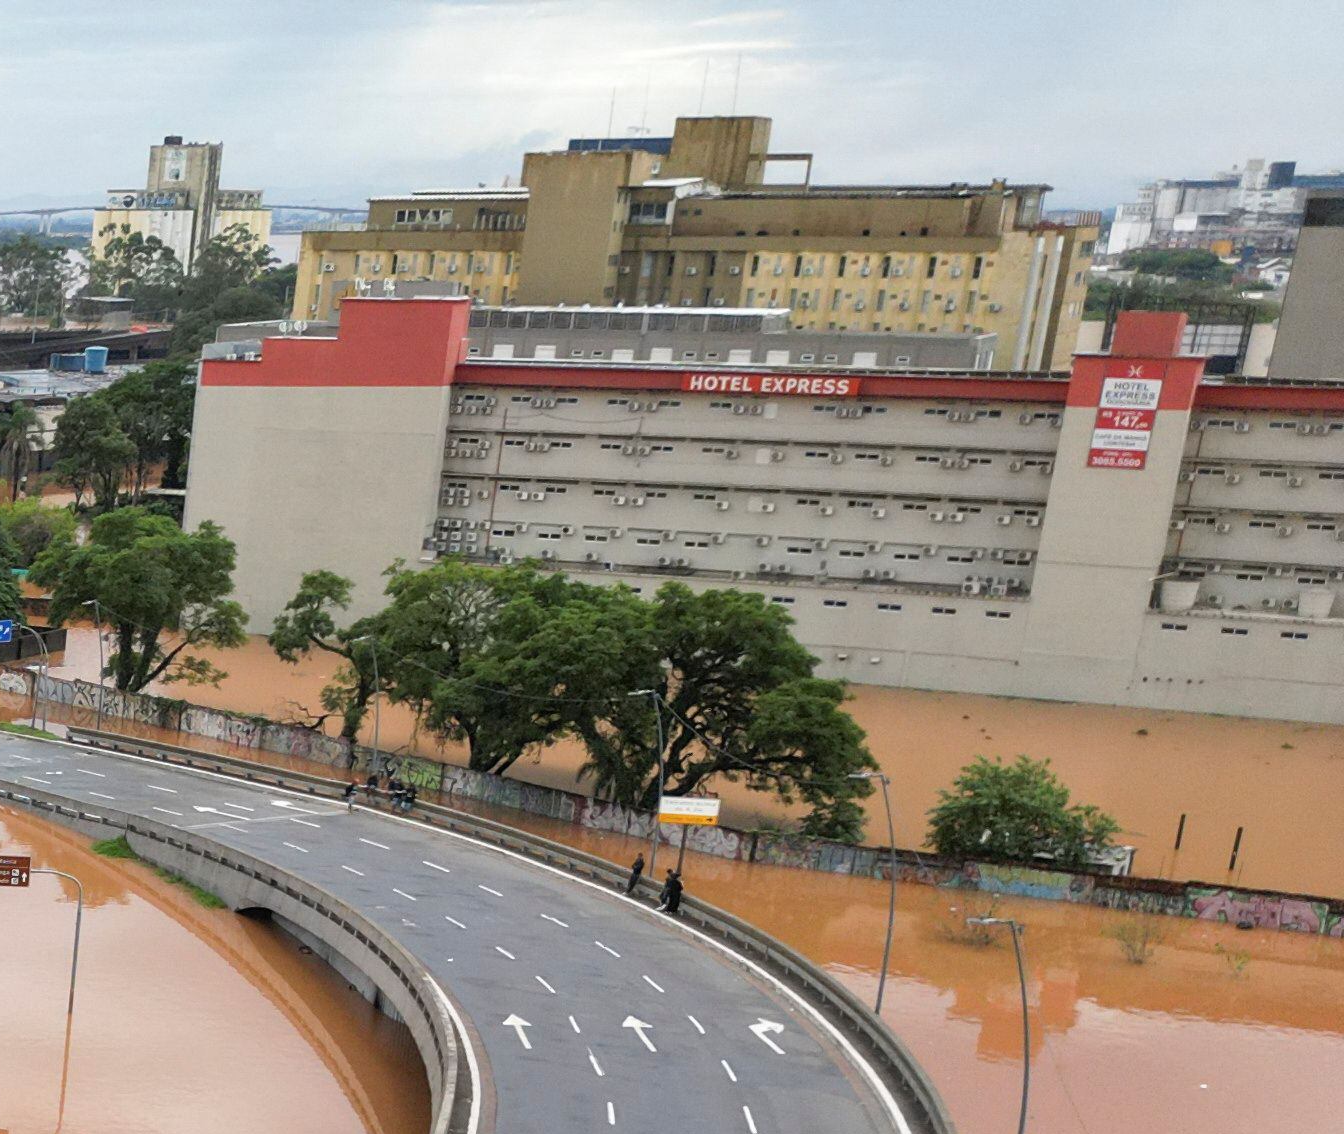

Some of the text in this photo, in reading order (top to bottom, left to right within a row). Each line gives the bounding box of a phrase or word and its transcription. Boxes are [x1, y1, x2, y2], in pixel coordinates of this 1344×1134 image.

[690, 375, 850, 395] HOTEL EXPRESS
[1114, 382, 1149, 391] HOTEL
[1105, 391, 1155, 400] EXPRESS
